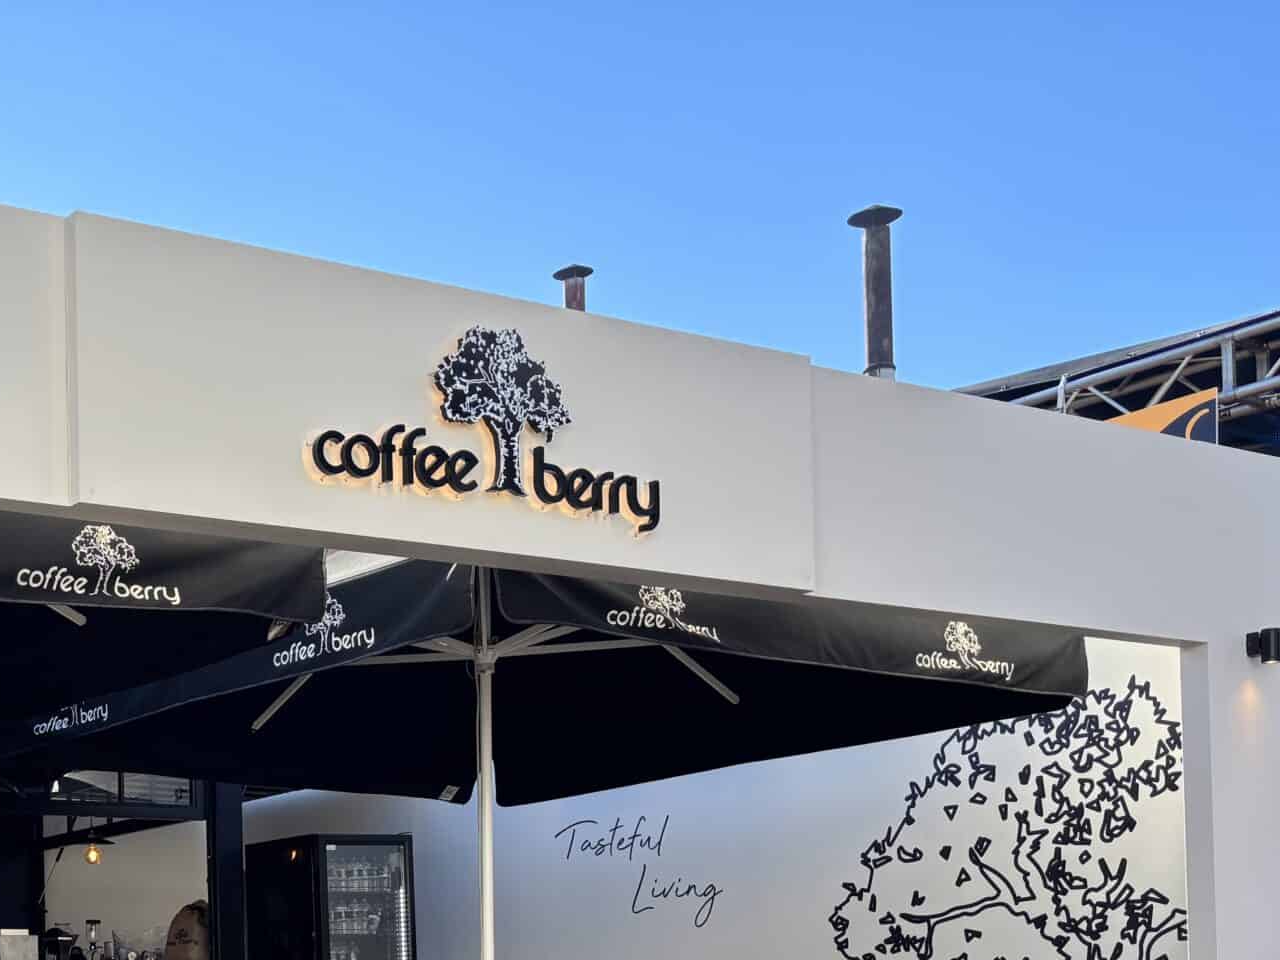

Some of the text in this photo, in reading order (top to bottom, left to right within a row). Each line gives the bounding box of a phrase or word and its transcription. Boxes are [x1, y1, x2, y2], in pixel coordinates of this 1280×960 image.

[312, 424, 661, 533] coffee berry
[16, 566, 181, 606] coffee berry
[606, 605, 667, 629] coffee
[273, 627, 375, 667] coffee berry
[915, 651, 1015, 681] coffee berry
[33, 703, 109, 736] coffee berry
[554, 814, 670, 861] Tasteful
[631, 863, 723, 928] Living
